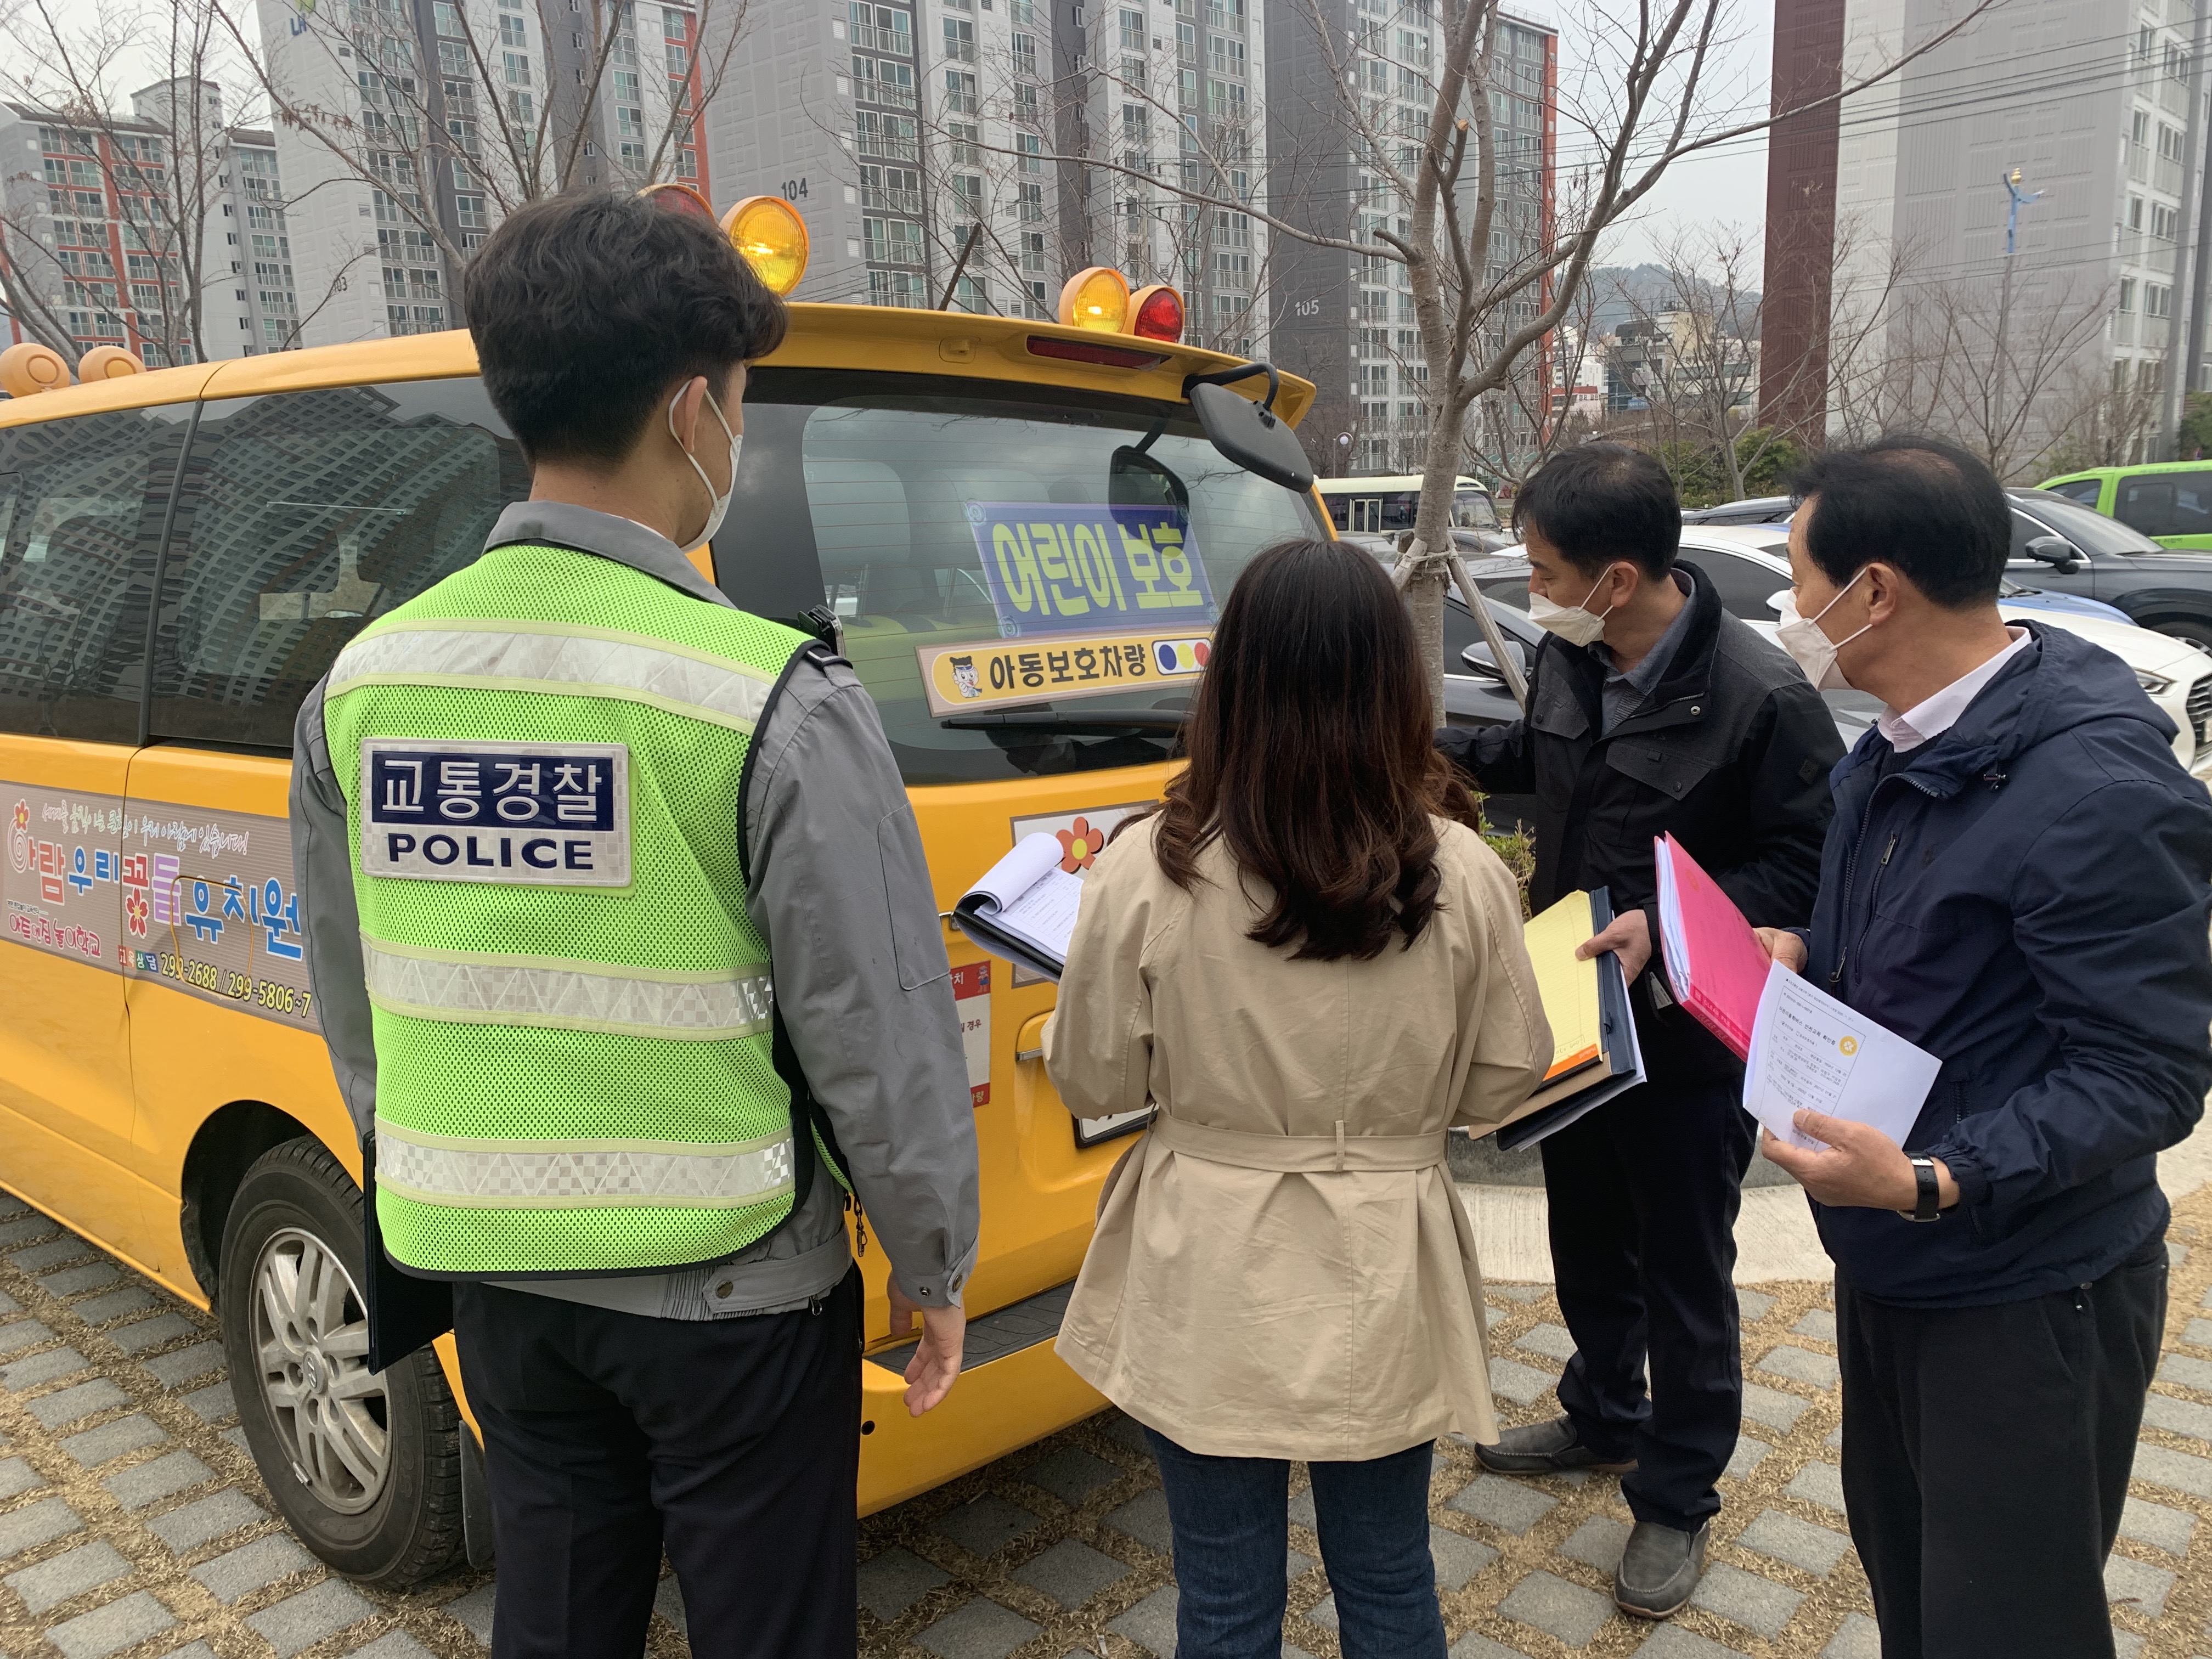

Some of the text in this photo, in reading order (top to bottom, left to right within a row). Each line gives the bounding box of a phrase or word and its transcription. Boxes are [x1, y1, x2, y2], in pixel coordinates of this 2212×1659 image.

[290, 13, 307, 36] LH
[781, 178, 808, 201] 104
[1295, 300, 1319, 316] 105
[992, 522, 1204, 616] 어린이 보호
[989, 643, 1147, 690] 아동보호차량
[382, 759, 603, 822] 교통경찰
[387, 832, 594, 870] POLICE
[160, 952, 218, 991] 299-2688
